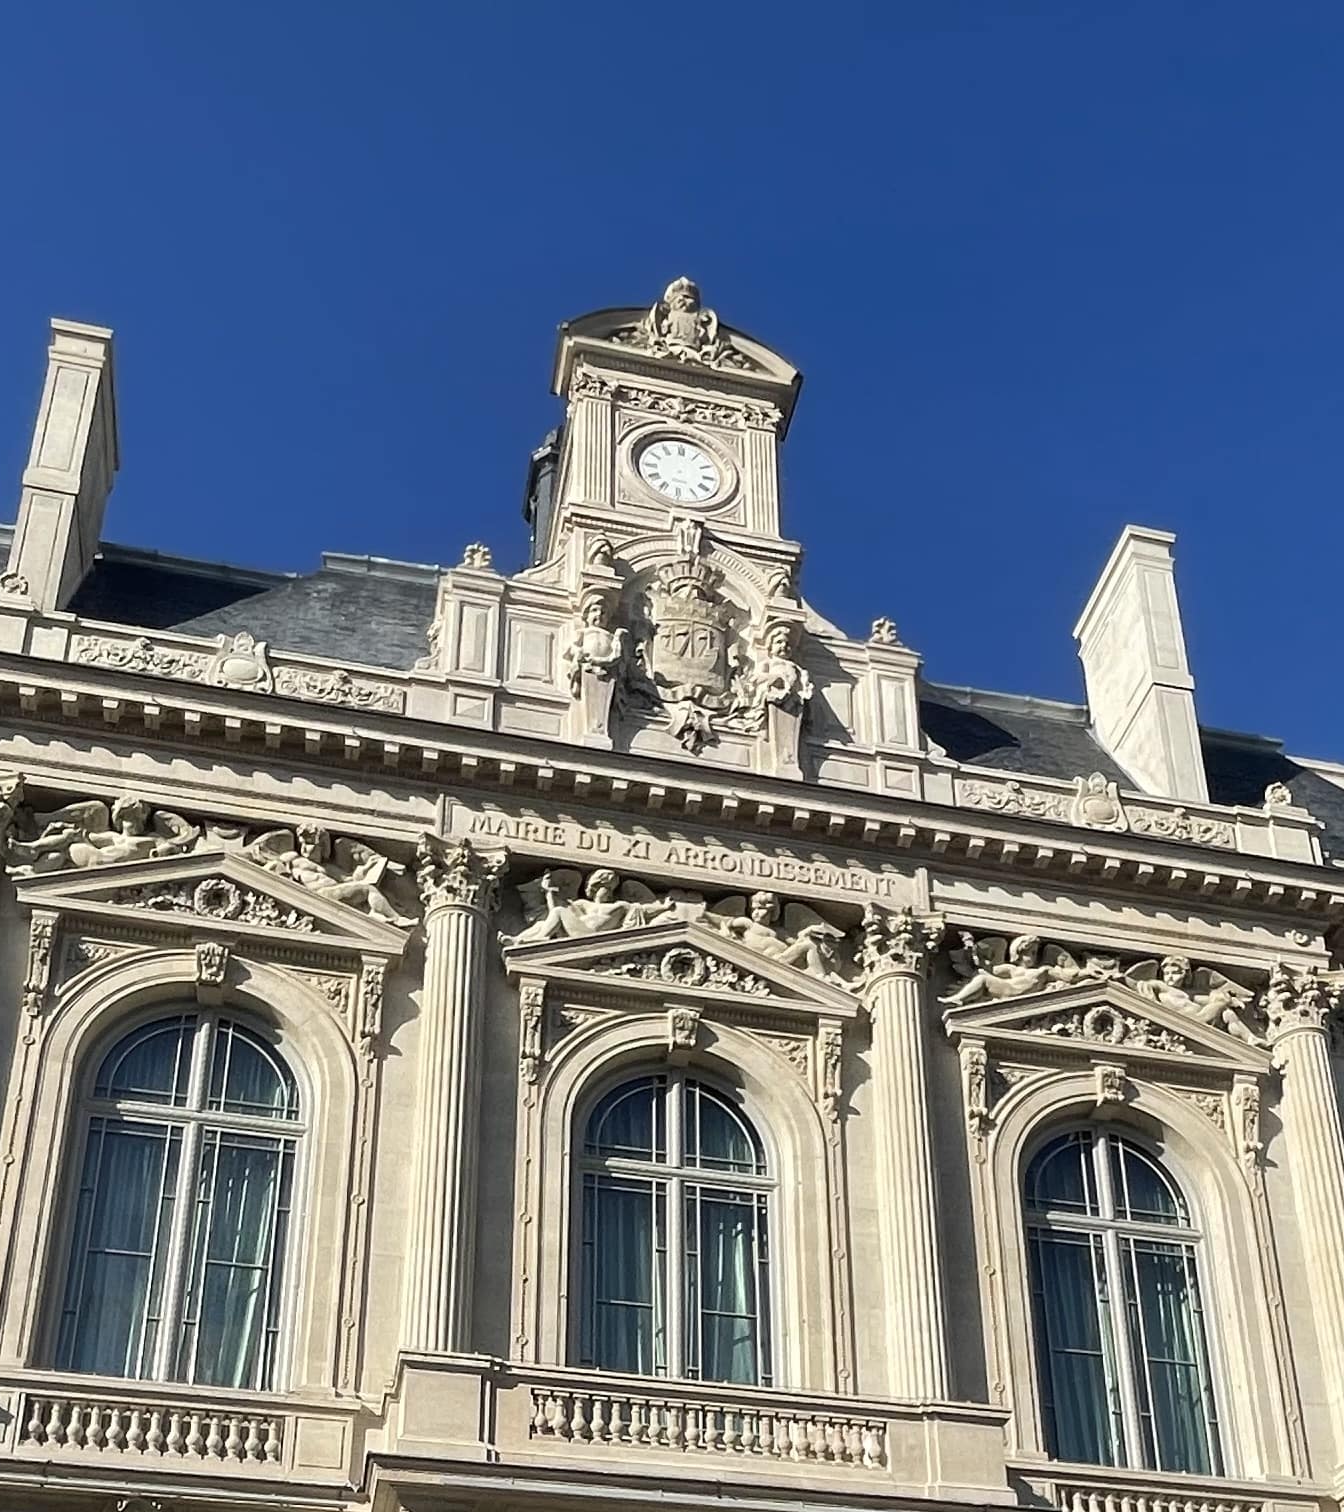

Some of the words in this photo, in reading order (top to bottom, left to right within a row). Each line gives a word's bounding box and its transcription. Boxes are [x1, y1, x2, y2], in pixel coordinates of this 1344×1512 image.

[469, 815, 566, 846] MAIRIE
[577, 829, 612, 853] DU
[622, 837, 651, 860] XI
[664, 846, 897, 897] ARRONDISSEMENT
